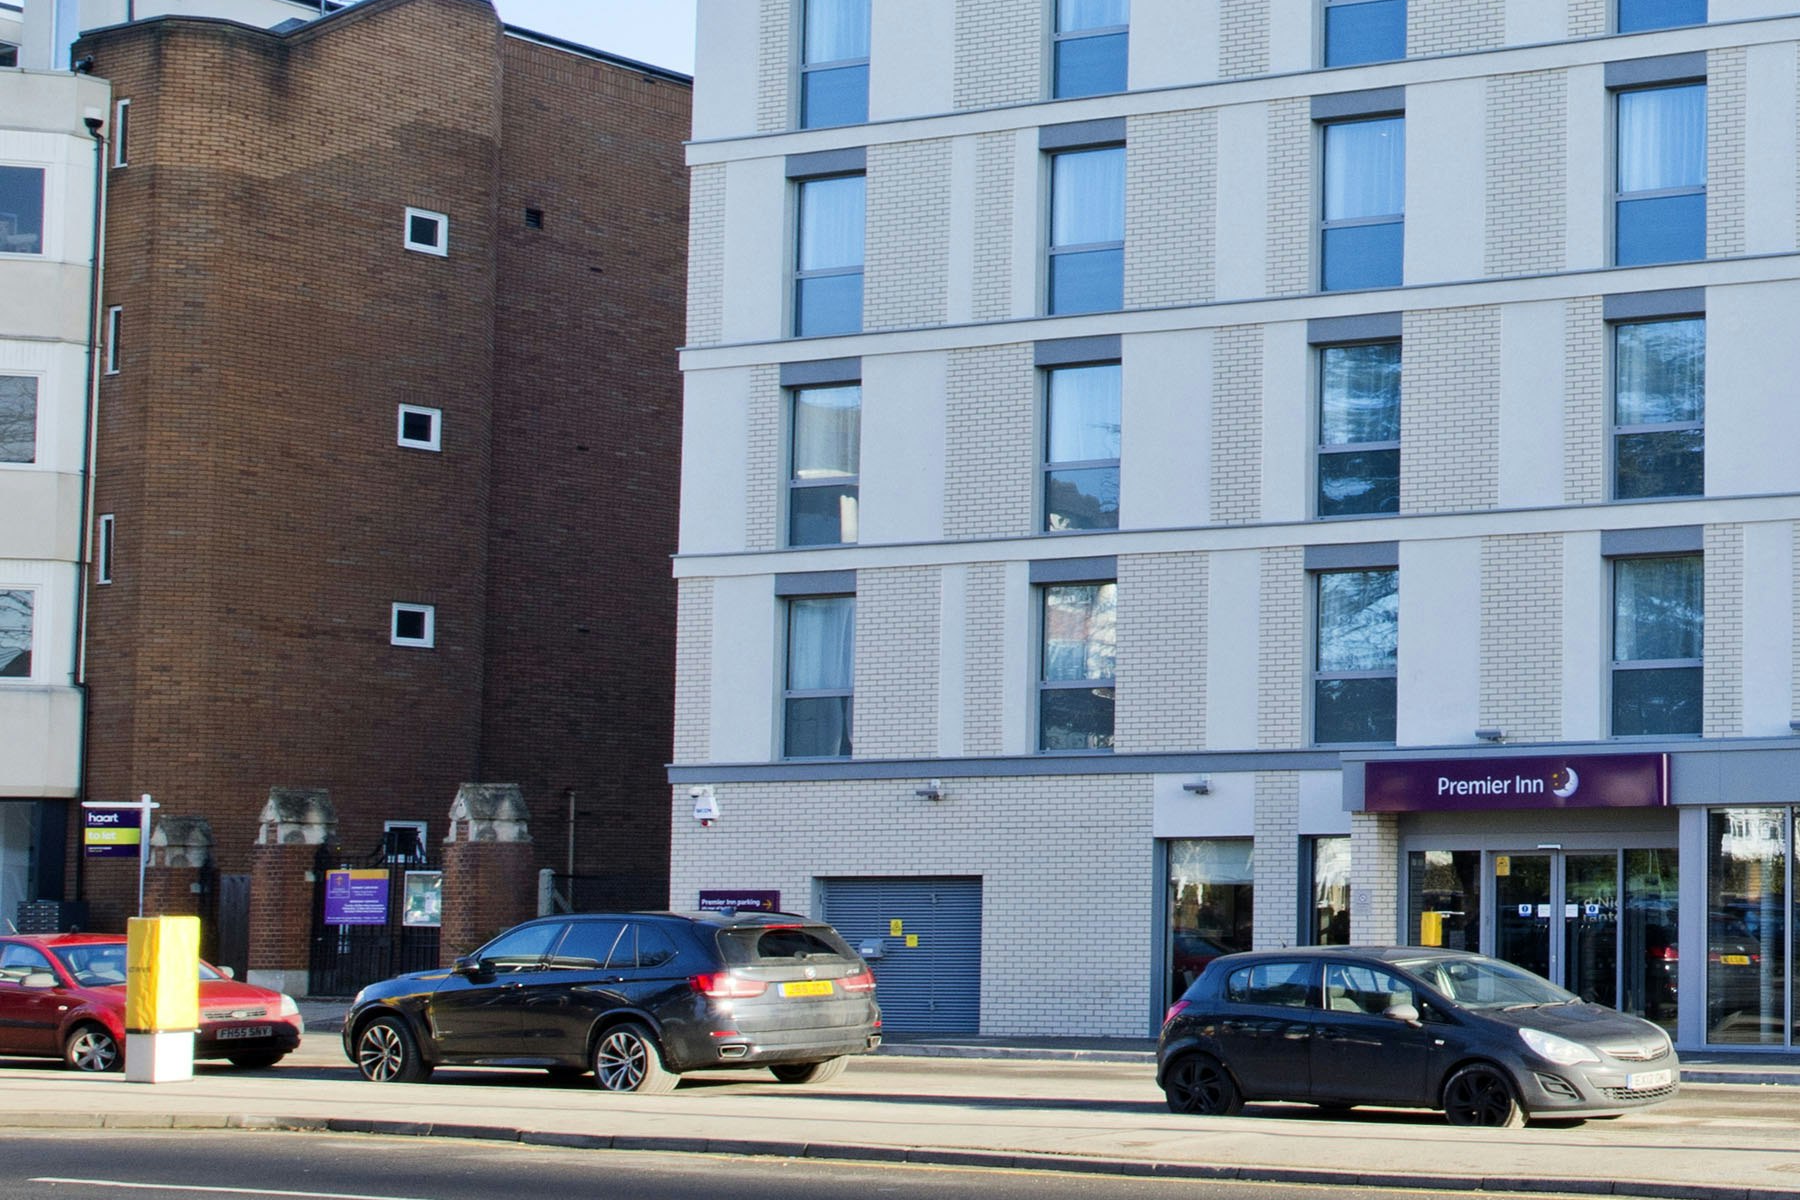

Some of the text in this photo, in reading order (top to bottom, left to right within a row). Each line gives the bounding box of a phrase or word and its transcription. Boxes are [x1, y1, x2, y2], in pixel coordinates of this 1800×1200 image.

[1437, 775, 1544, 796] Premier Inn
[88, 811, 119, 823] haart
[88, 831, 117, 840] to let
[737, 899, 761, 908] parking
